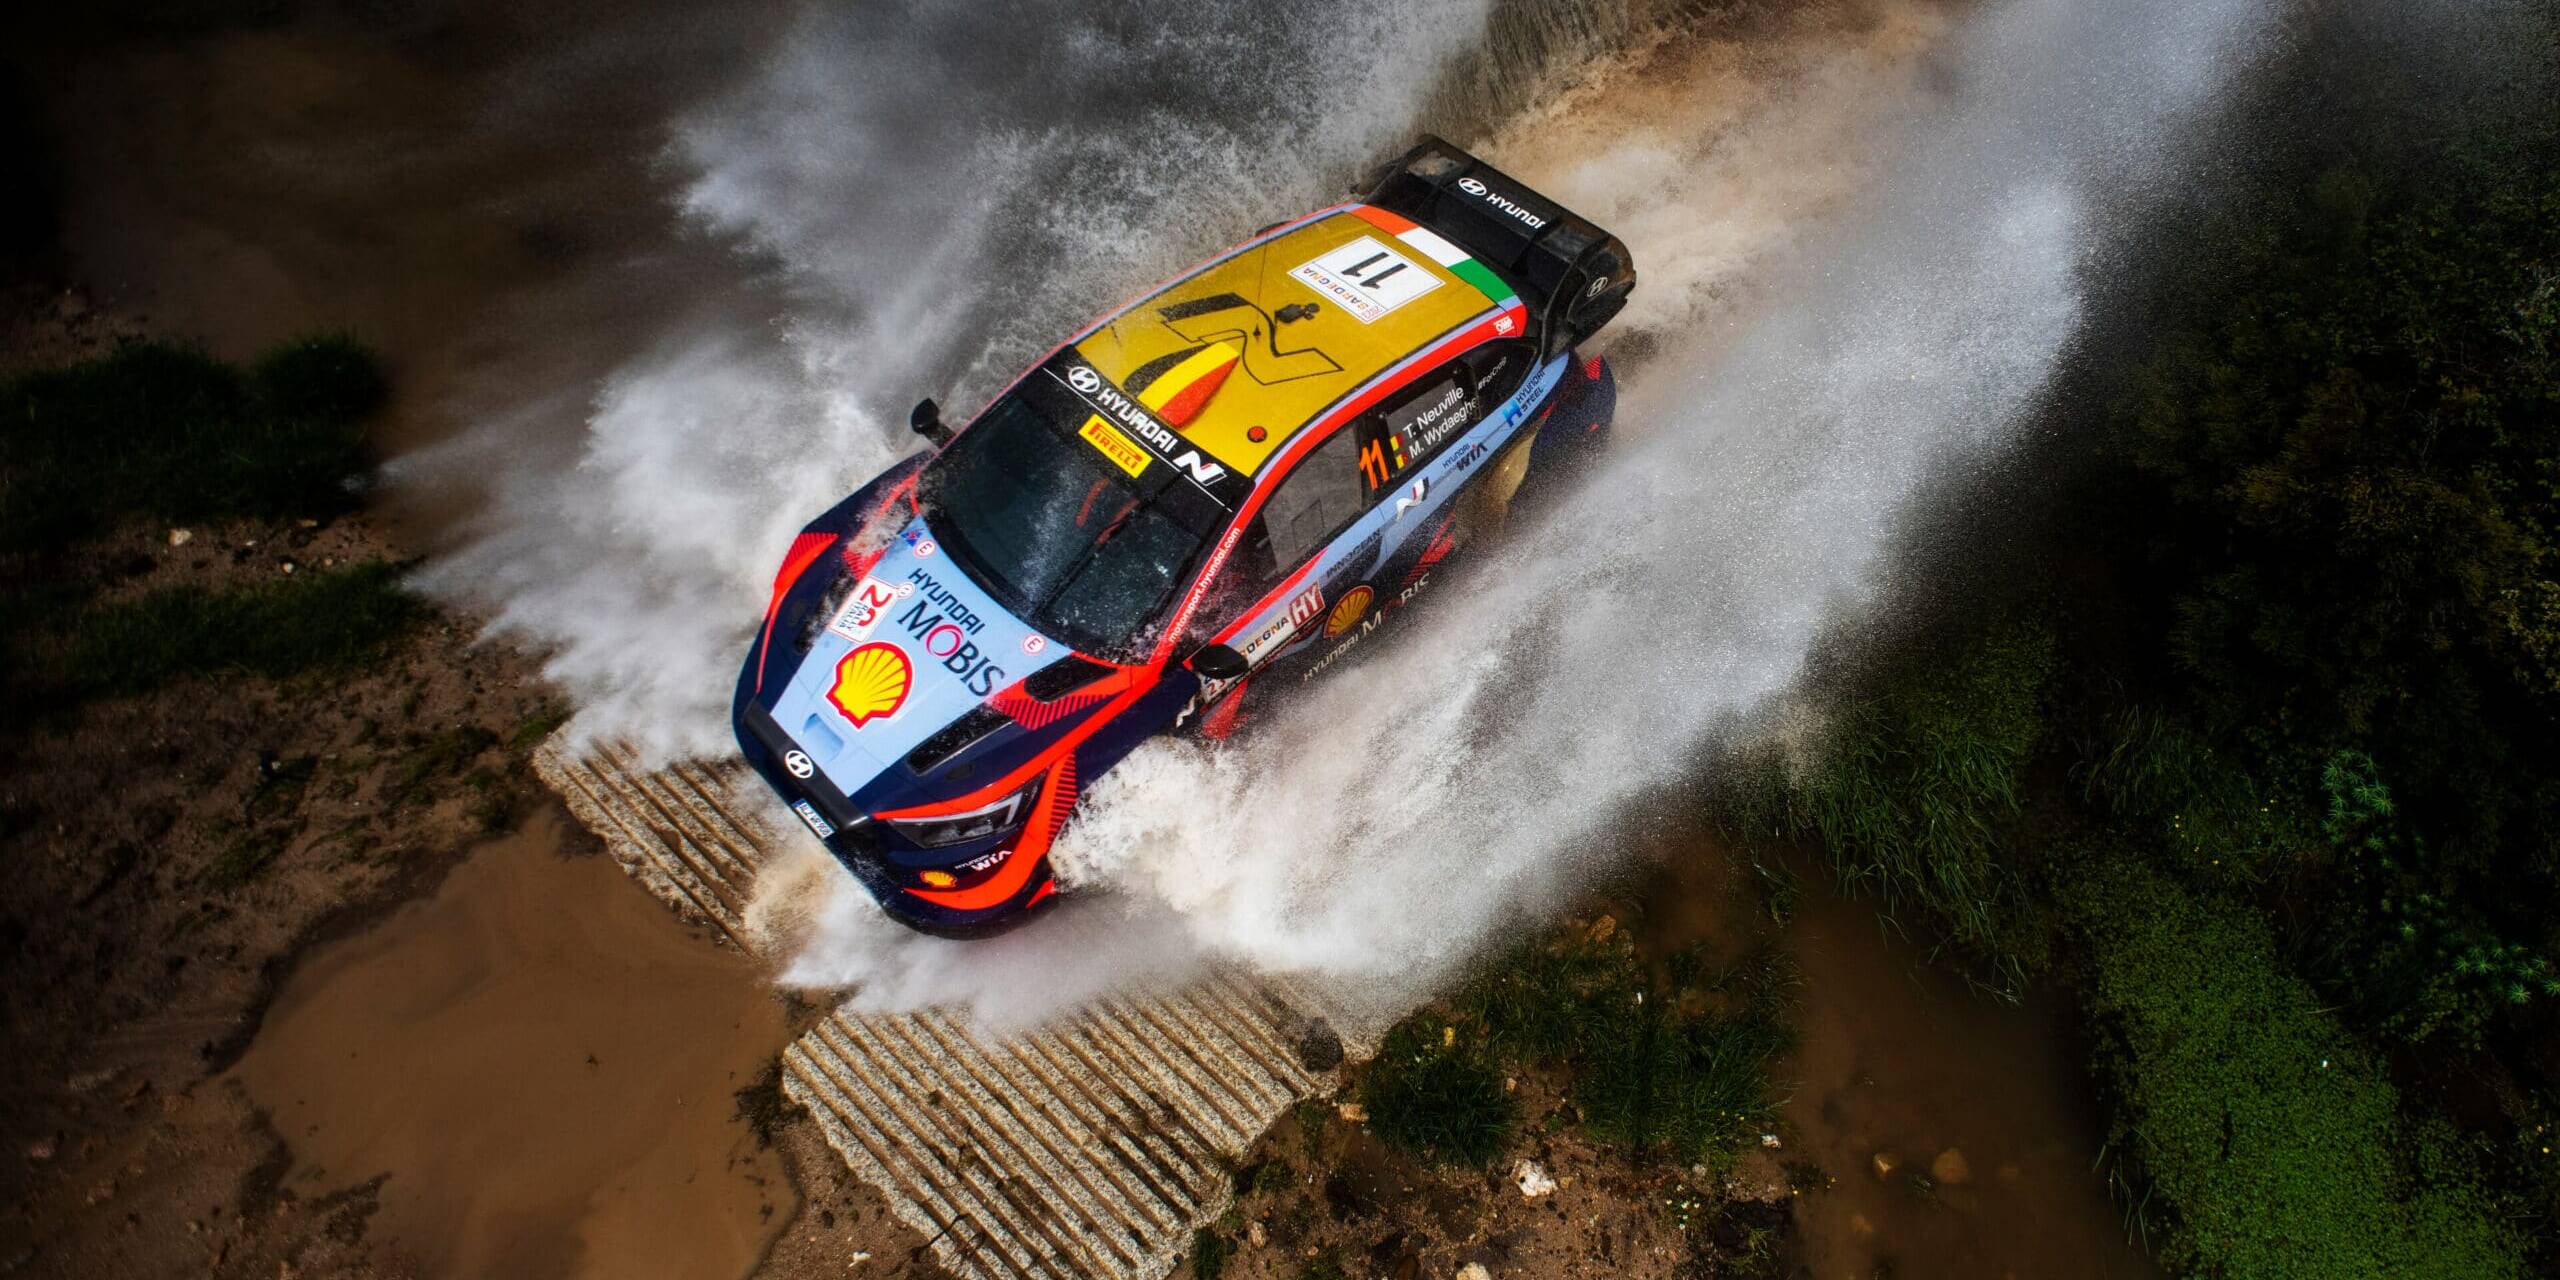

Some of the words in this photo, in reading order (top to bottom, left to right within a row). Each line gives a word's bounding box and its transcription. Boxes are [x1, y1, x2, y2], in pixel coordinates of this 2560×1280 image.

[1303, 267, 1369, 310] SARDEGNA
[1341, 252, 1409, 289] 11
[1516, 368, 1546, 404] HYUNDAI
[1520, 388, 1545, 412] STEEL
[1097, 388, 1178, 453] HYUNDAI
[1403, 424, 1417, 439] T.
[1416, 386, 1464, 430] Neuville
[1088, 422, 1143, 470] PIRELLI
[1360, 439, 1390, 491] 11
[1408, 441, 1424, 459] M.
[1442, 443, 1470, 469] HYUNDAI
[908, 567, 986, 635] HYUNDAI
[1169, 527, 1240, 643] motorsport.hyundai.com
[1292, 582, 1320, 624] HY
[897, 600, 1005, 697] MOBIS
[1303, 634, 1359, 681] HYUNDAI
